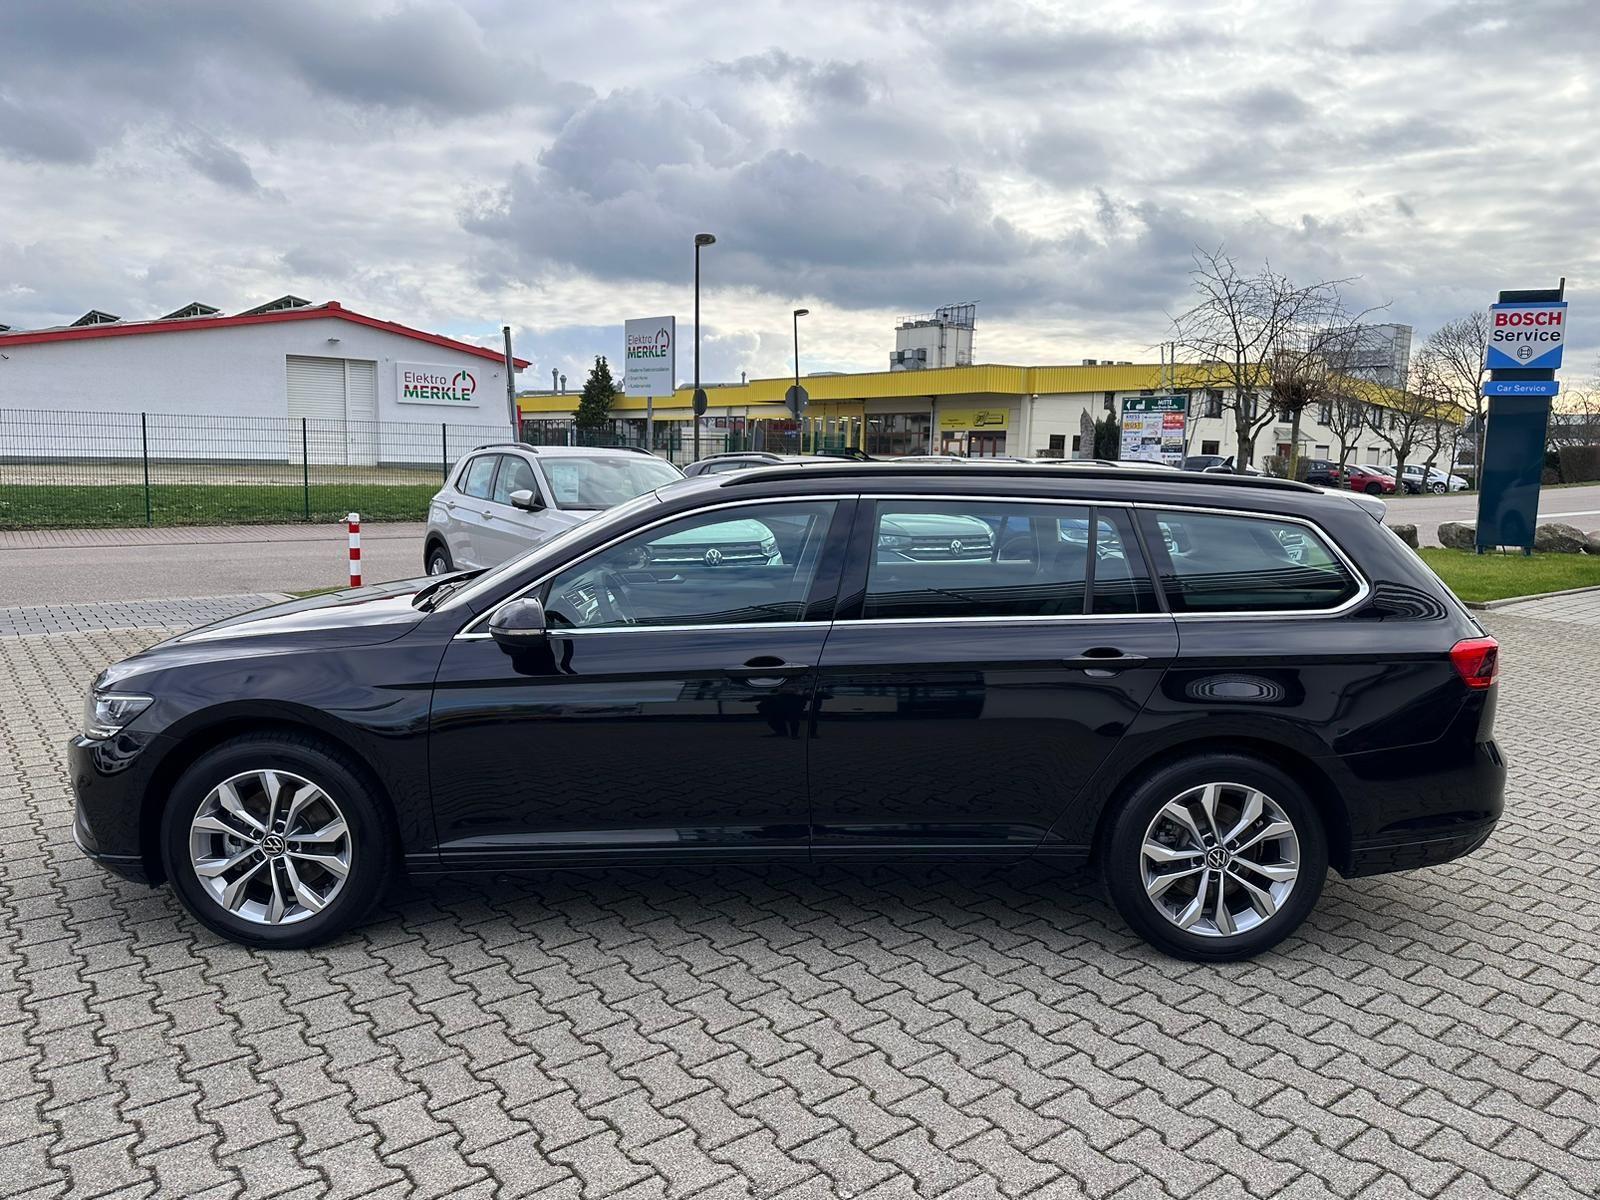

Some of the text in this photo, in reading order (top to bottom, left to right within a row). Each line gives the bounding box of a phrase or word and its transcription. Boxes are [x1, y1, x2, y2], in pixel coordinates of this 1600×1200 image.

[1495, 312, 1562, 327] BOSCH
[628, 335, 653, 345] Elektro
[1492, 328, 1561, 342] Service
[627, 345, 667, 359] MERKLE
[404, 371, 447, 385] Elektro
[403, 384, 471, 401] MERKLE
[1496, 384, 1546, 392] Car Service
